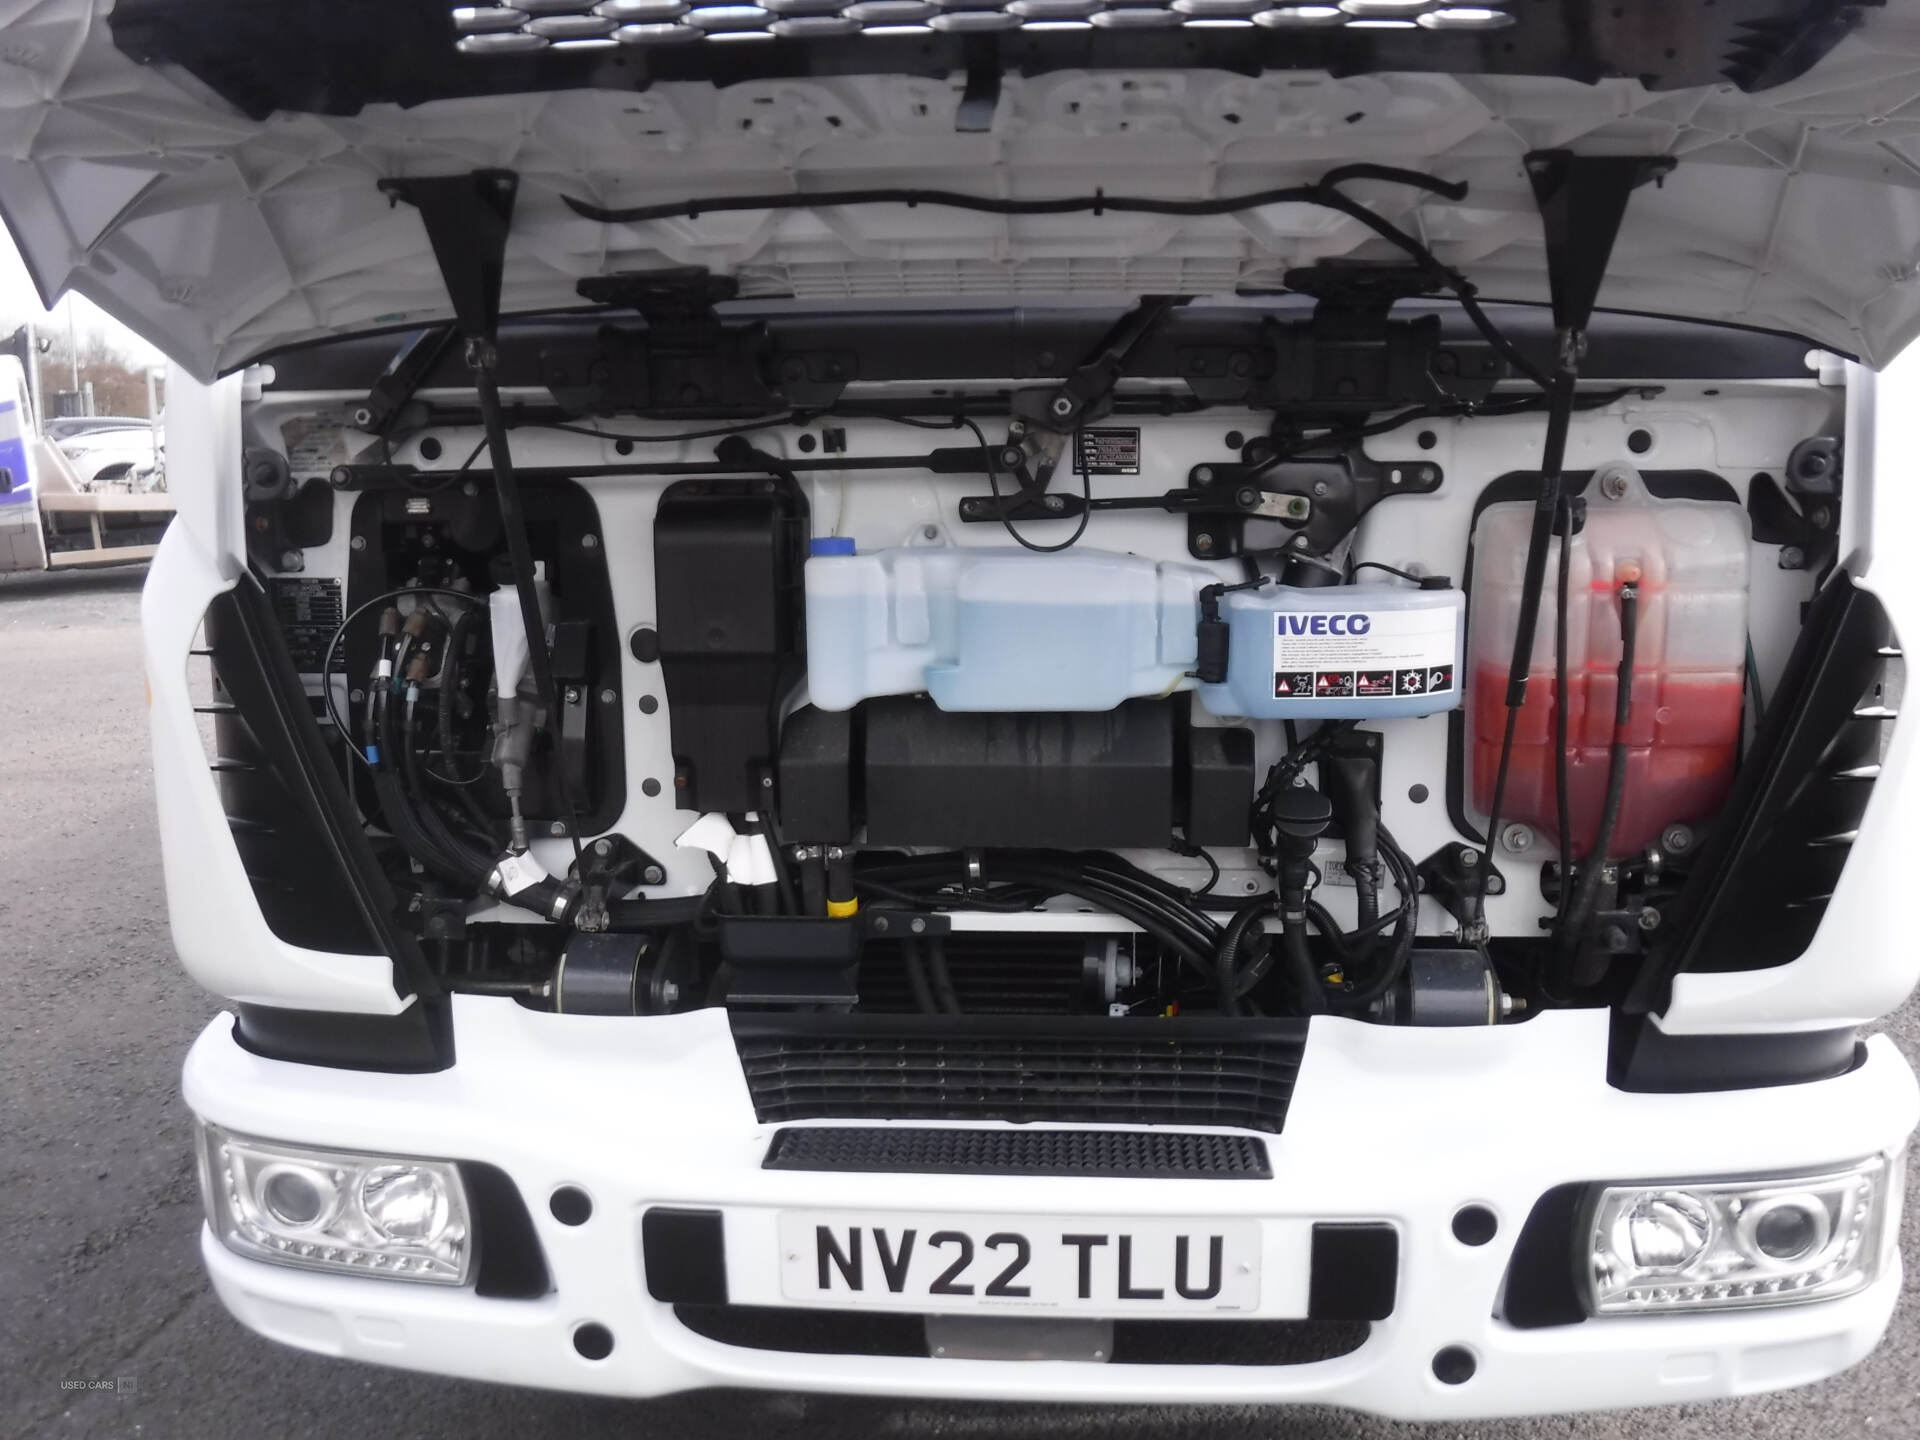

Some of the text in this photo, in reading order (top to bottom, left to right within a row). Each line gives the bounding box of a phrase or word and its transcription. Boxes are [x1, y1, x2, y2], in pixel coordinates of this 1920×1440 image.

[1278, 614, 1371, 636] IVECO
[815, 1225, 1224, 1300] NV22 TLU
